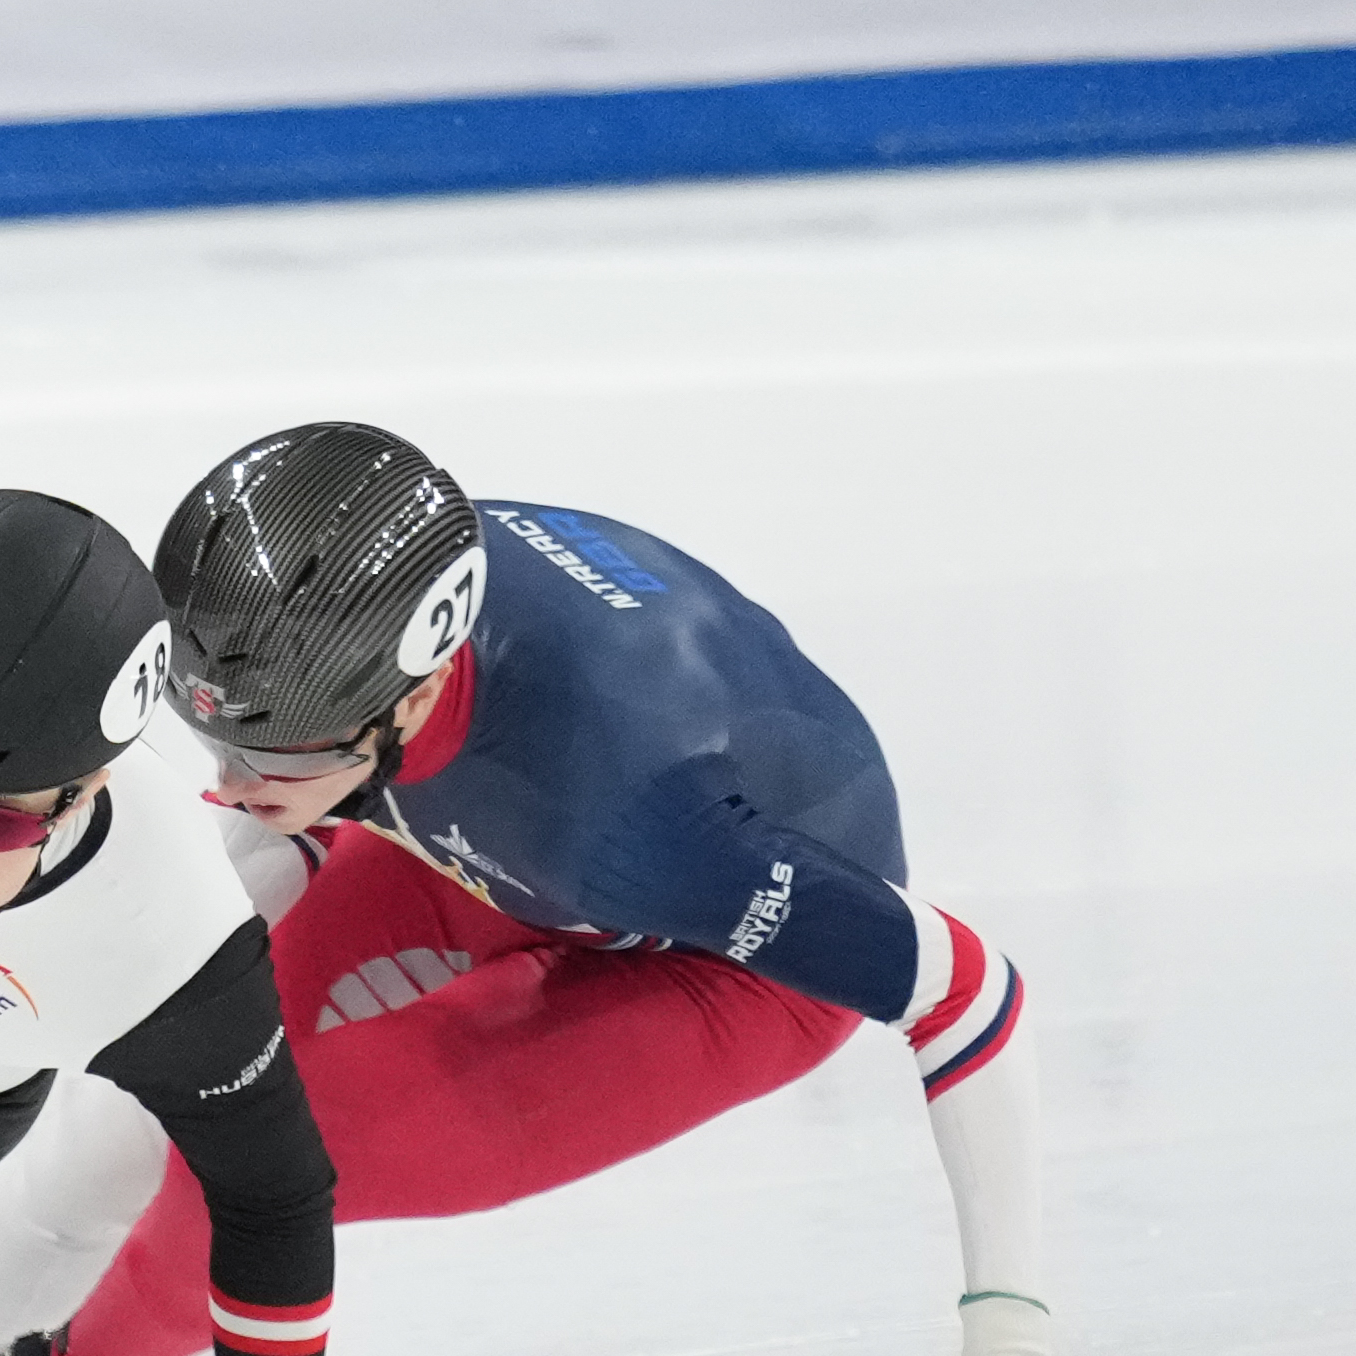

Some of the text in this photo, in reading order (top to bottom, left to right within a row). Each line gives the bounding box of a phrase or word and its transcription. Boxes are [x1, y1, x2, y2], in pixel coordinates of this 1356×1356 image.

[430, 567, 473, 660] 27
[133, 641, 166, 720] 18
[725, 861, 794, 964] ROYALS
[729, 889, 767, 941] BRITISH
